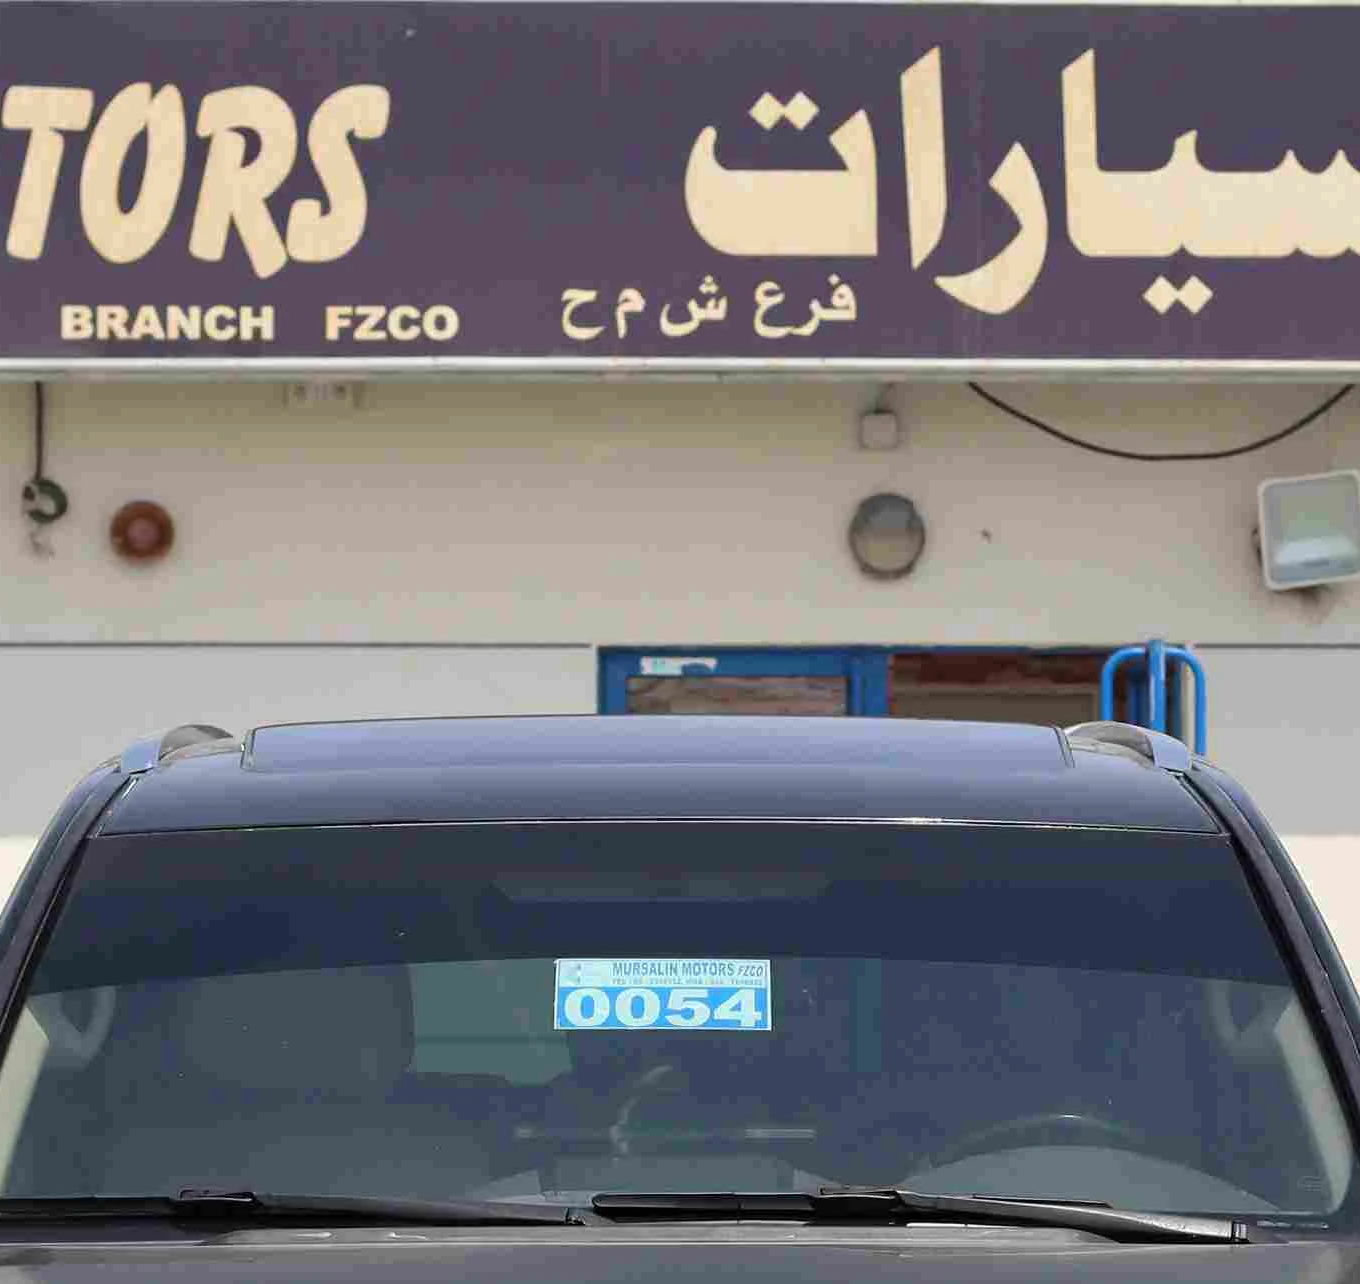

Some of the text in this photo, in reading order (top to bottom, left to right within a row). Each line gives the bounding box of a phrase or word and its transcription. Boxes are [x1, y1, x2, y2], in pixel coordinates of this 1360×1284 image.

[60, 304, 460, 342] BRANCH FZCO
[560, 273, 858, 341] فرع ش م ح
[611, 961, 678, 977] MURSALIN
[681, 961, 735, 977] MOTORS
[563, 987, 762, 1028] 0054
